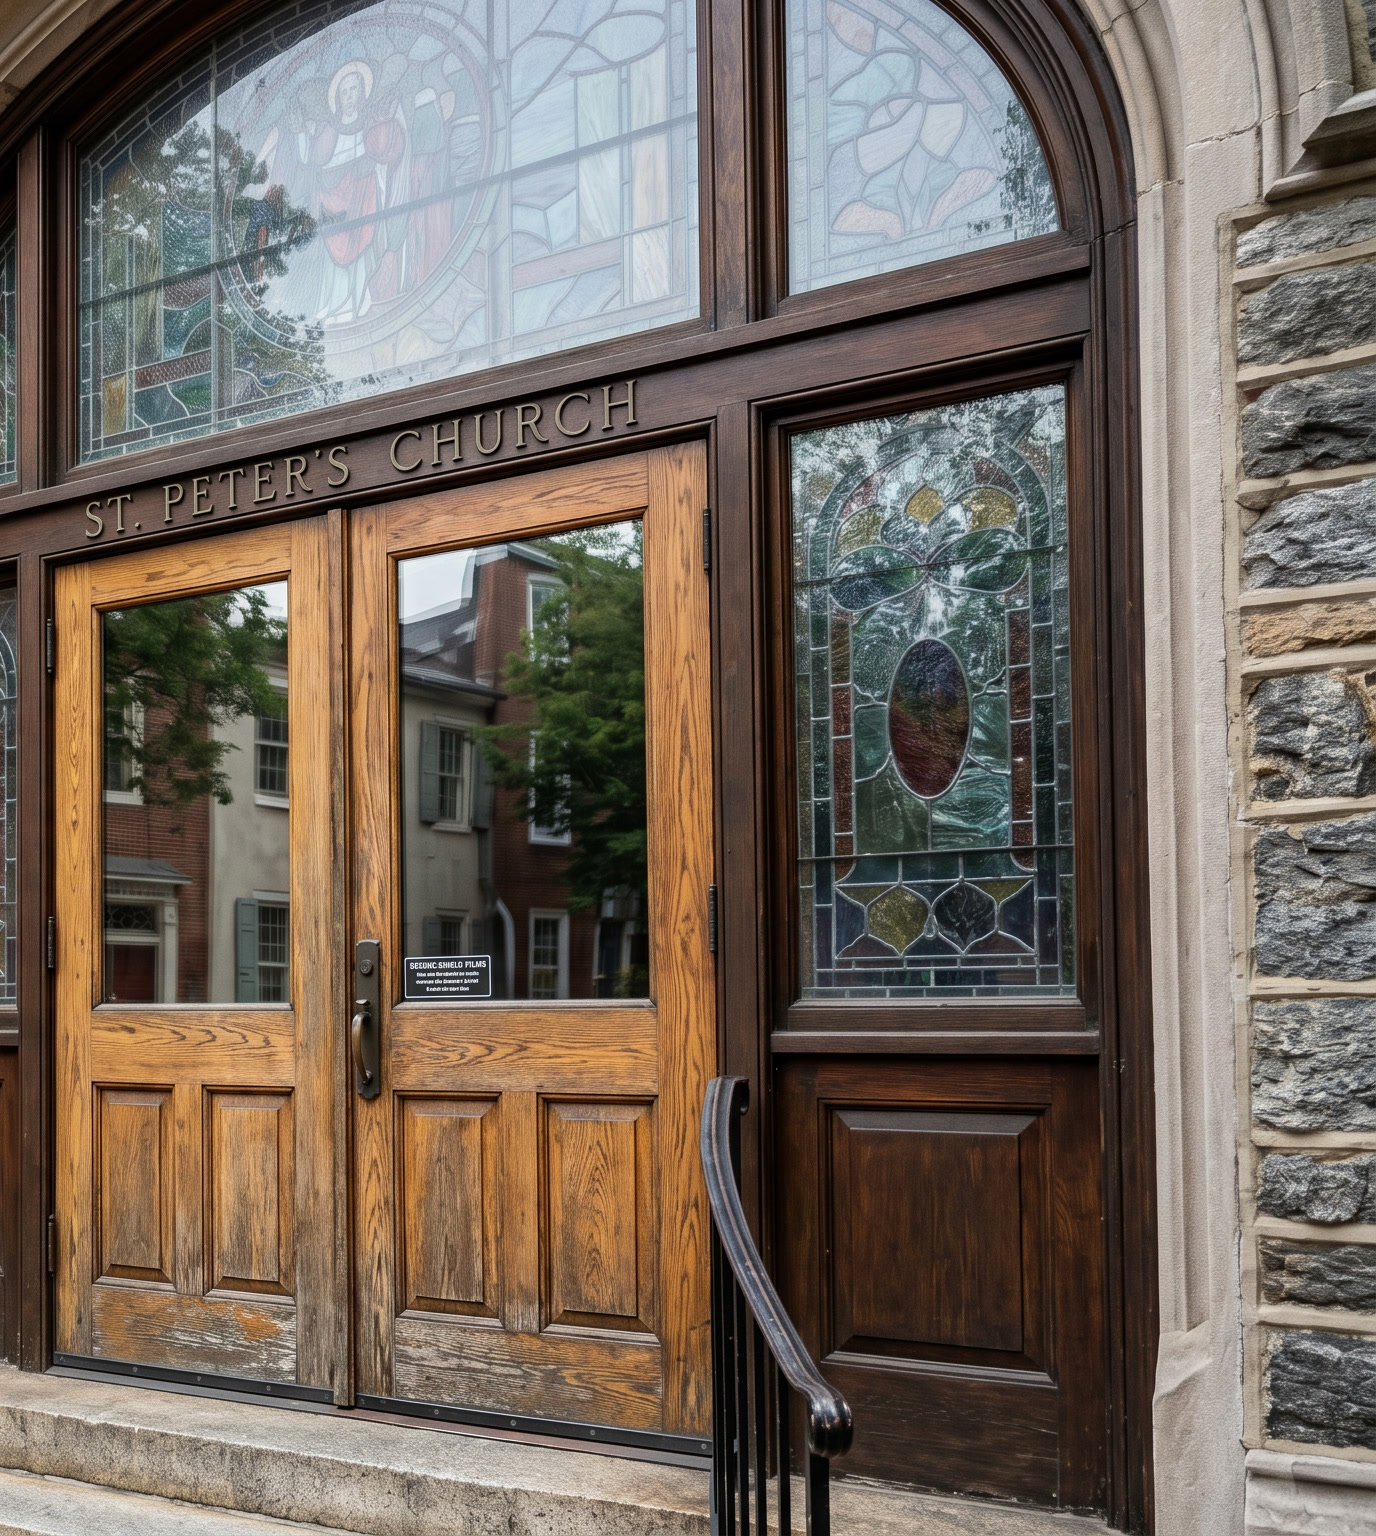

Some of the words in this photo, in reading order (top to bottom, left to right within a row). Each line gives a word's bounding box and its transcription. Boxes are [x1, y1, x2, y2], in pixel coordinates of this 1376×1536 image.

[84, 493, 142, 539] ST.
[162, 446, 350, 523] PETER'S
[390, 379, 639, 472] CHURCH
